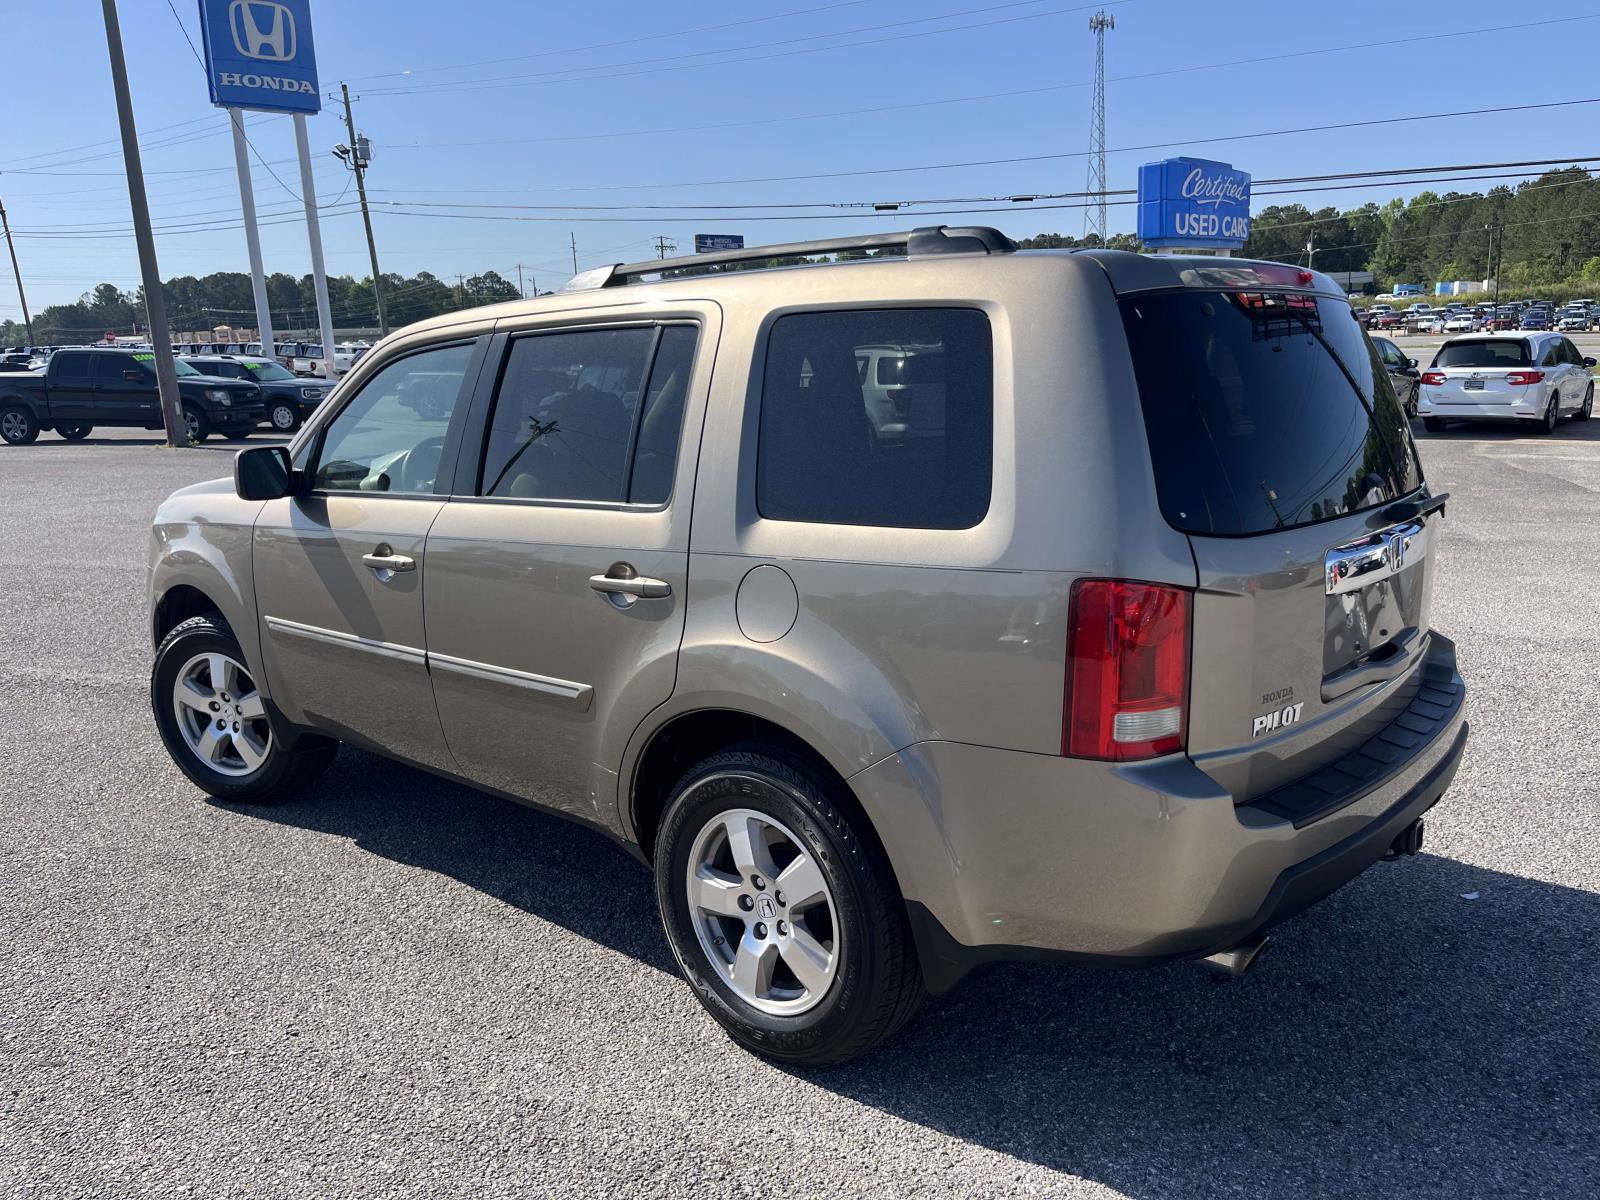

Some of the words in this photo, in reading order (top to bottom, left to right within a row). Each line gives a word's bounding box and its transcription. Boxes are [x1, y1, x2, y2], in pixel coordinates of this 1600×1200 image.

[219, 72, 317, 95] HONDA
[1182, 168, 1247, 208] Certified
[1175, 213, 1219, 236] USED
[1222, 216, 1248, 237] CARS
[1262, 686, 1294, 704] HONDA
[1252, 702, 1304, 737] PILOT
